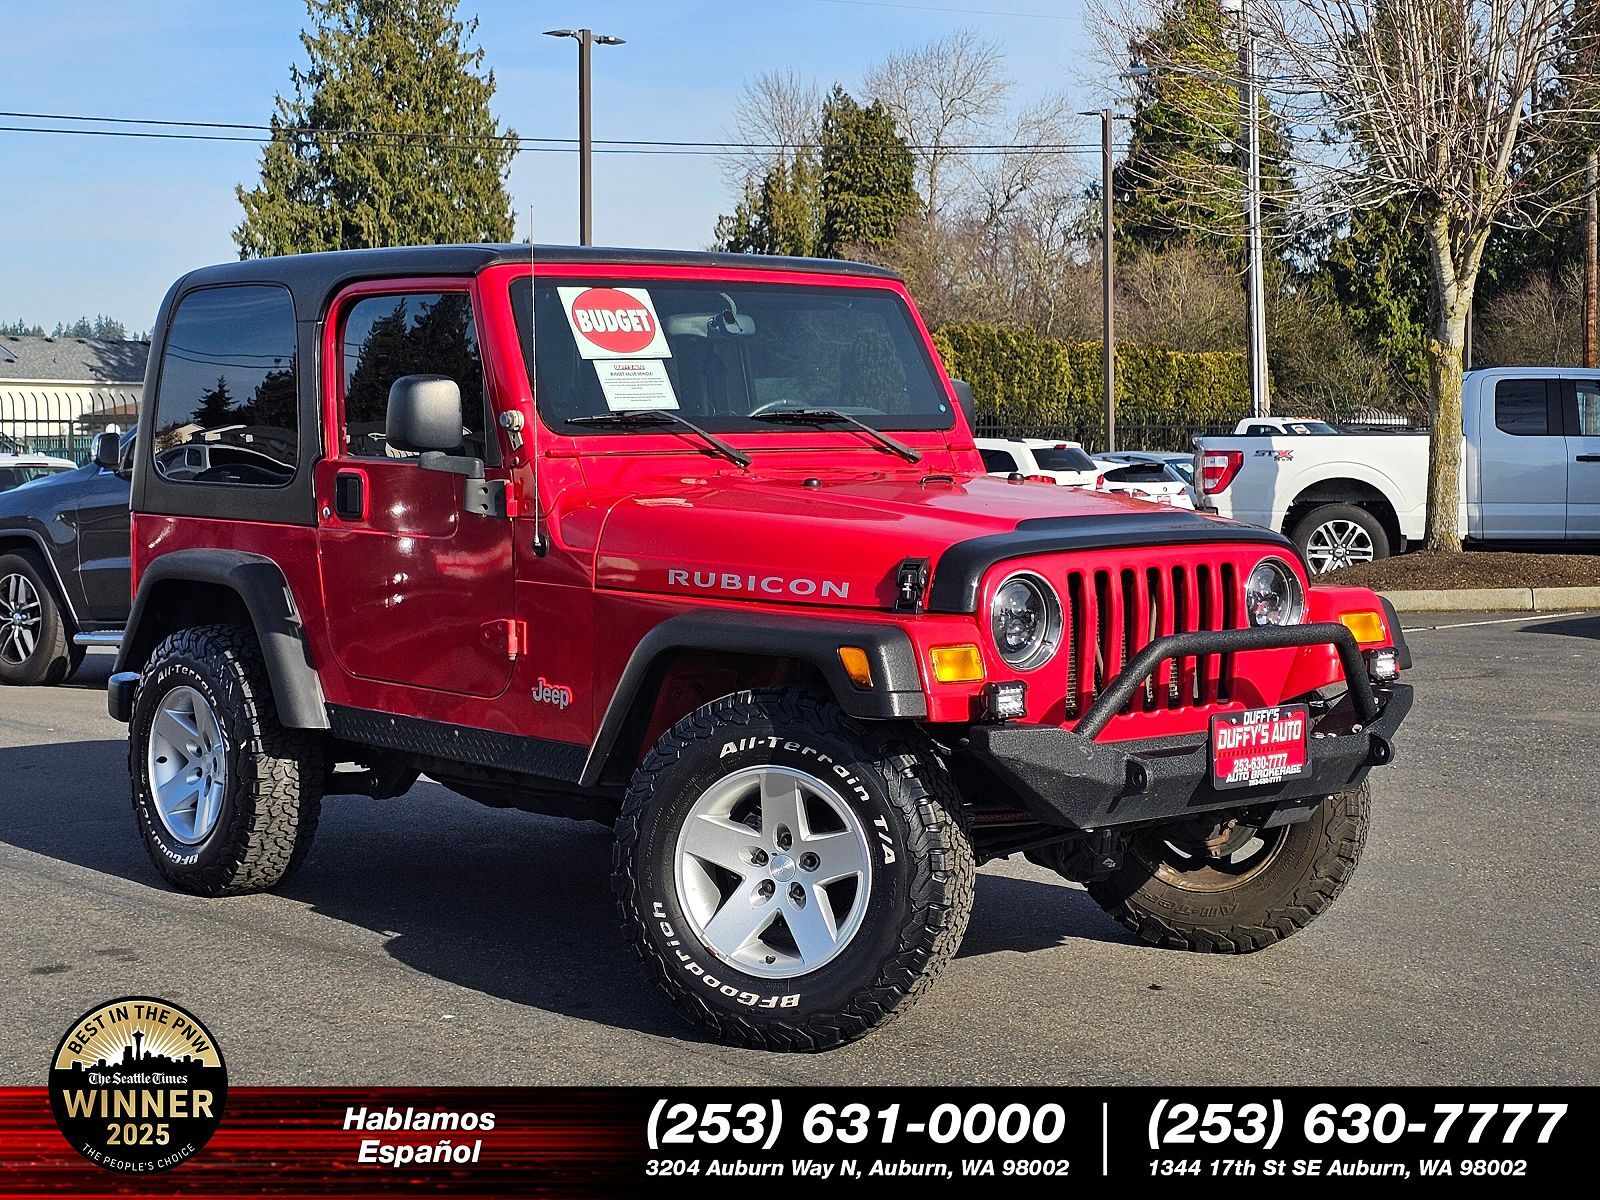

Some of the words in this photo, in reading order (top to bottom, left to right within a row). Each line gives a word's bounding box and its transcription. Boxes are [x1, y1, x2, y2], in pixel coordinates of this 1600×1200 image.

[575, 309, 651, 332] BUDGET
[668, 569, 849, 598] RUBICON
[532, 680, 569, 709] Jeep
[1243, 708, 1280, 725] DUFFY'S
[1218, 724, 1269, 749] DUFFY'S
[1271, 720, 1302, 743] AUTO
[1225, 772, 1249, 783] AUTO
[1251, 764, 1302, 779] BROKERAGE
[1234, 753, 1288, 773] 253-630-7777
[720, 736, 870, 802] All-Terrain
[873, 814, 897, 865] T/A
[653, 901, 801, 1009] BFGoodrich
